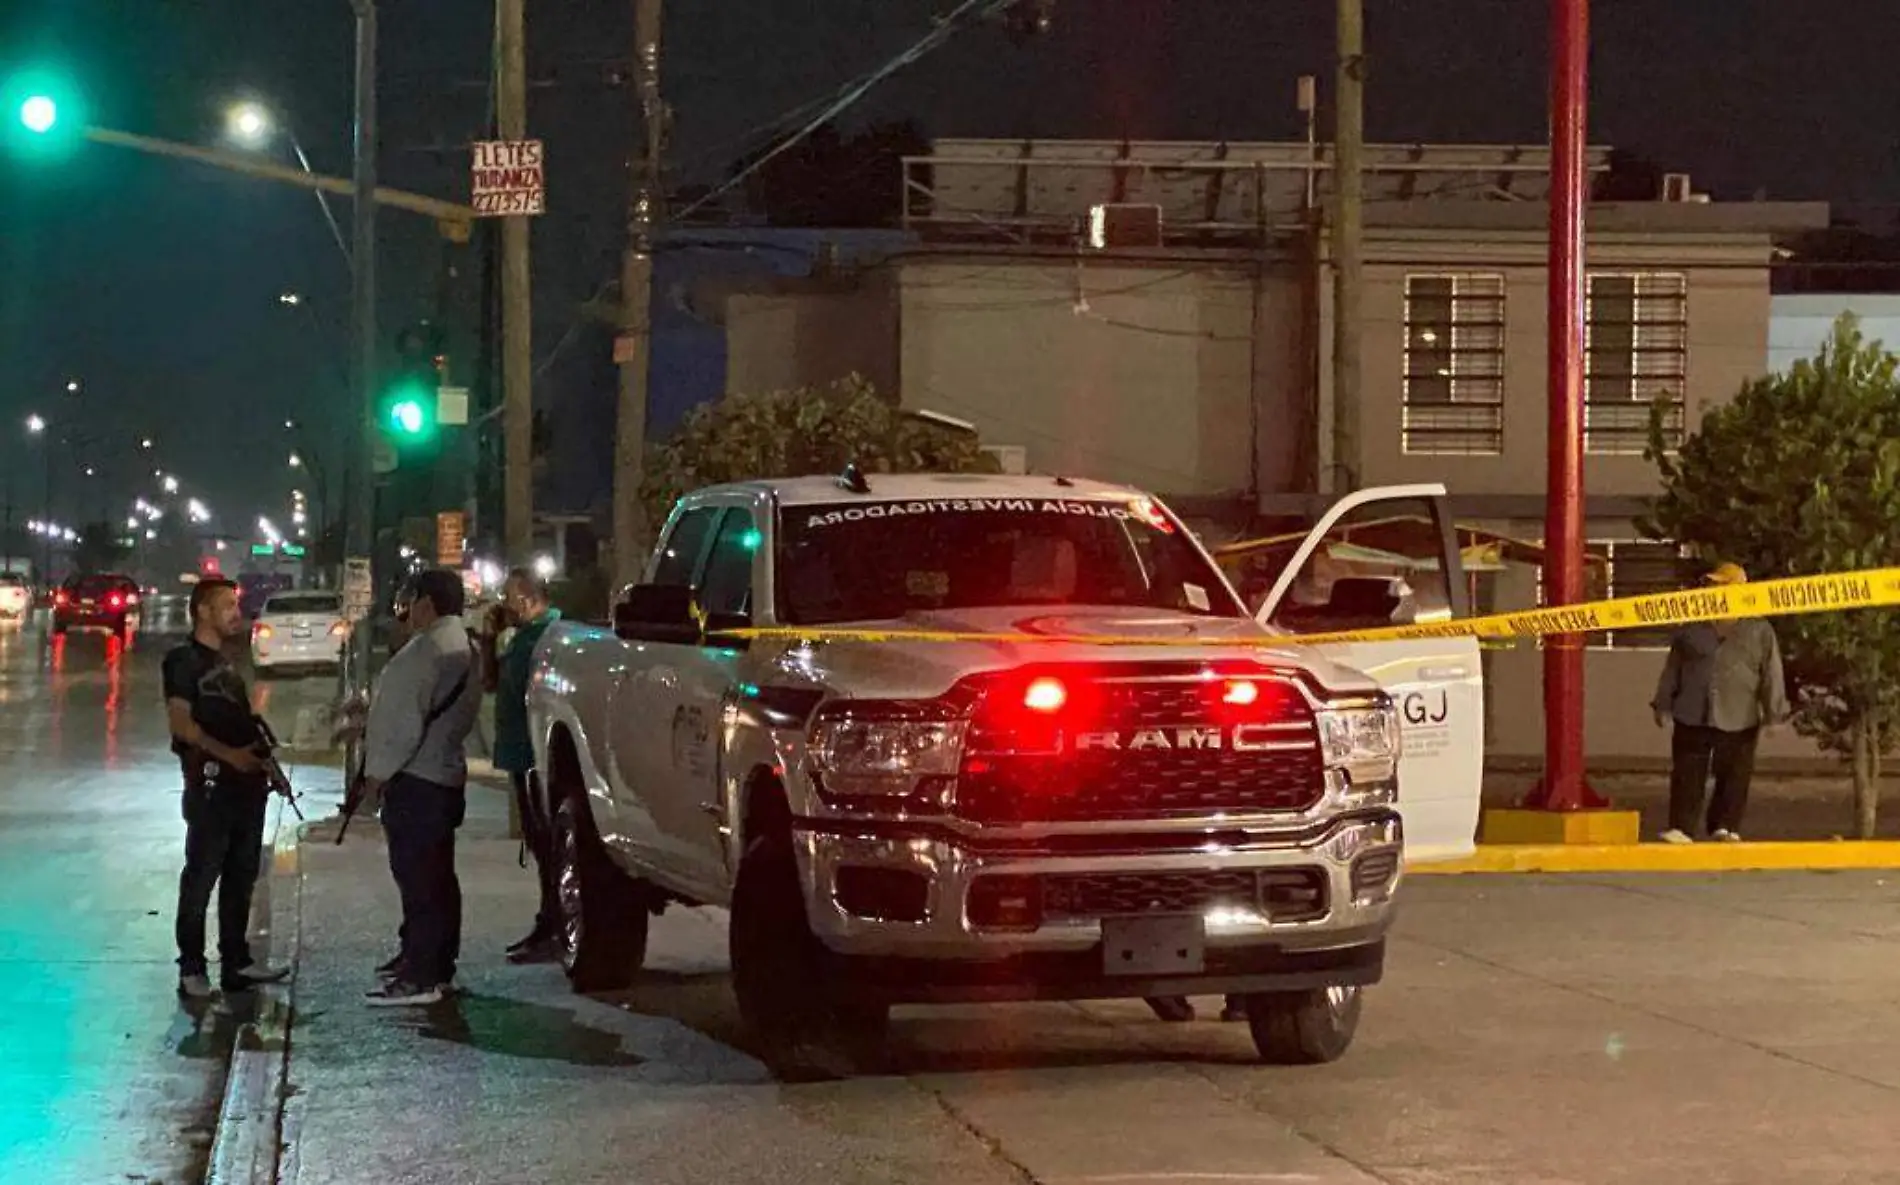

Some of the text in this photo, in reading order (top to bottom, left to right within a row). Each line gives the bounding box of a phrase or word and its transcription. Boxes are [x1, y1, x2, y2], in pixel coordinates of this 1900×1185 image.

[1768, 579, 1871, 608] PRECAUCION
[1633, 594, 1729, 622] PRECAUCION
[1075, 727, 1222, 750] RAM
